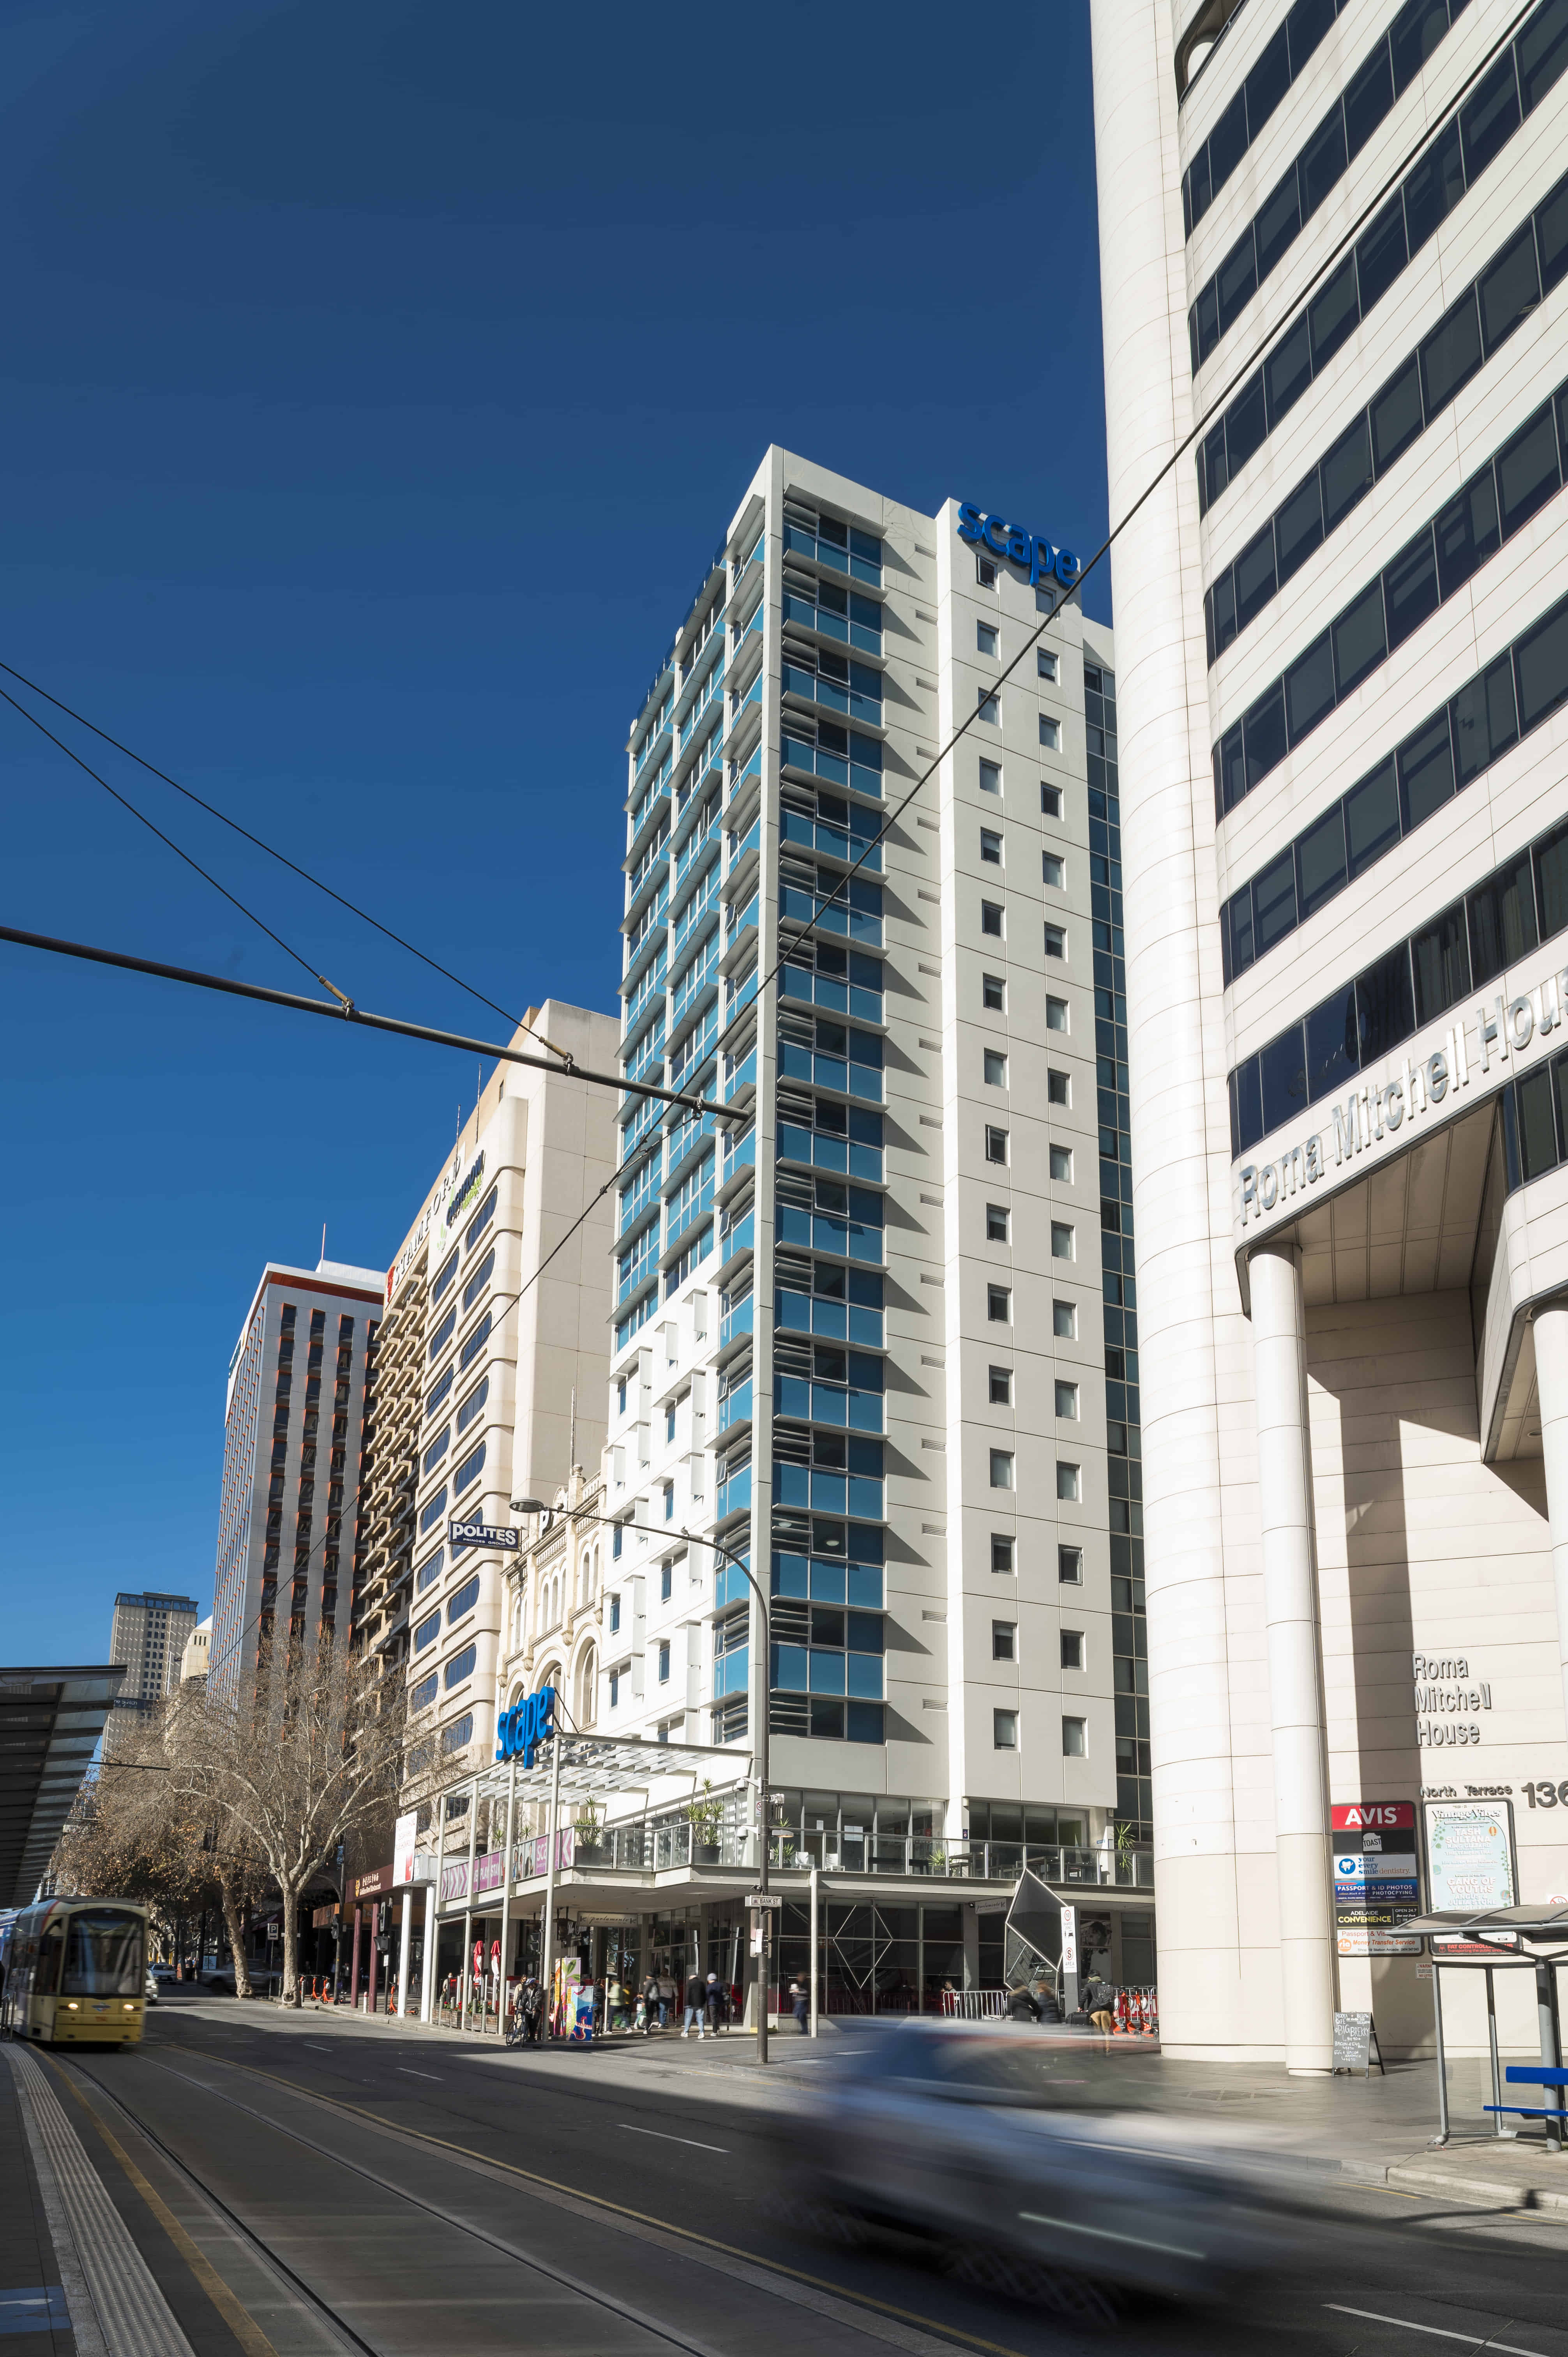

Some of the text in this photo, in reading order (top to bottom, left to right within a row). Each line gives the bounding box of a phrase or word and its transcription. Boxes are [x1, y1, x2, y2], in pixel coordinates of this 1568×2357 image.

[957, 502, 1078, 590] scape
[1238, 1134, 1324, 1226] Roma
[1332, 1021, 1469, 1165] Mitchell
[394, 1156, 462, 1286] STAMFORD
[452, 1523, 516, 1545] POLITES
[1412, 1654, 1468, 1680] Roma
[1414, 1682, 1491, 1712] Mitchell
[496, 1686, 555, 1769] scape
[1416, 1719, 1481, 1746] House
[1420, 1785, 1513, 1798] North Terrace
[1345, 1807, 1397, 1825] AVIS
[1432, 1808, 1501, 1820] Vintage Vibes
[1363, 1838, 1381, 1847] TOAST
[1445, 1836, 1491, 1844] SULTANA
[1447, 1877, 1497, 1886] GANG OF
[1338, 2025, 1369, 2037] BIG BREKKY
